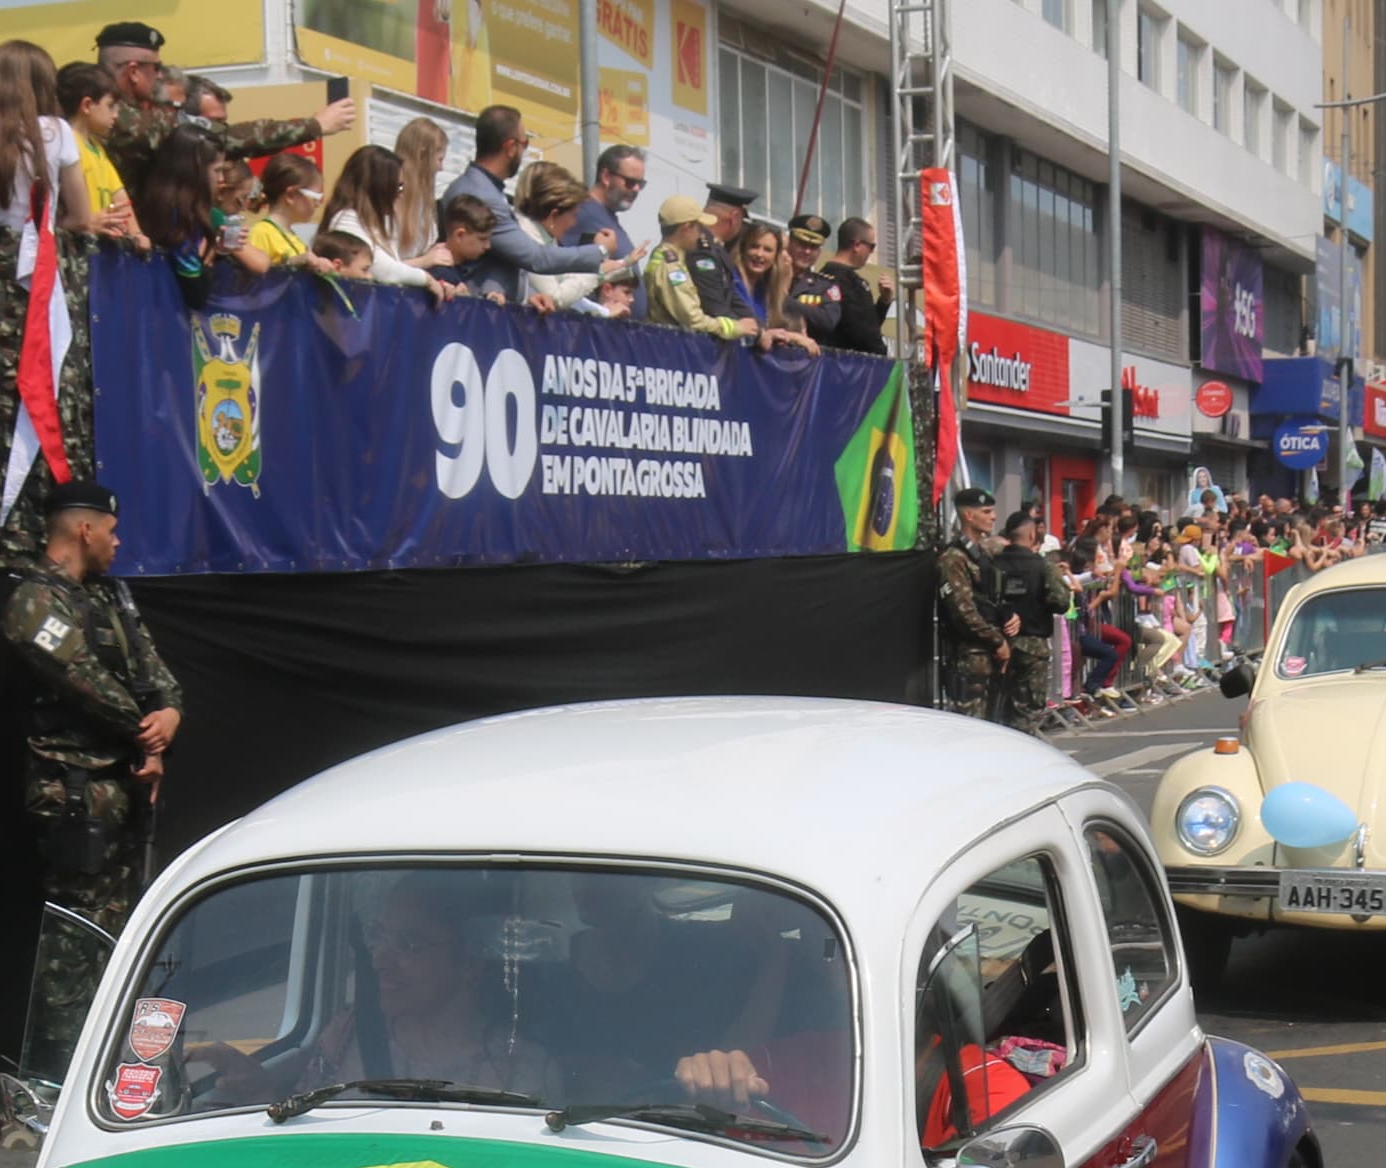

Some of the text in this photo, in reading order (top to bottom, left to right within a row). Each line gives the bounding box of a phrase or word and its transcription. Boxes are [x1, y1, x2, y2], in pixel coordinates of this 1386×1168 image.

[542, 354, 599, 400] ANOS
[600, 361, 625, 402] DA
[644, 366, 721, 411] BRIGADA
[971, 341, 1031, 392] Santander
[430, 341, 537, 499] 90
[541, 404, 753, 457] DE CAVALARIA BLINDADA
[1279, 433, 1321, 451] ÓTICA
[541, 453, 707, 499] EM PONTA GROSSA
[34, 615, 70, 653] PE
